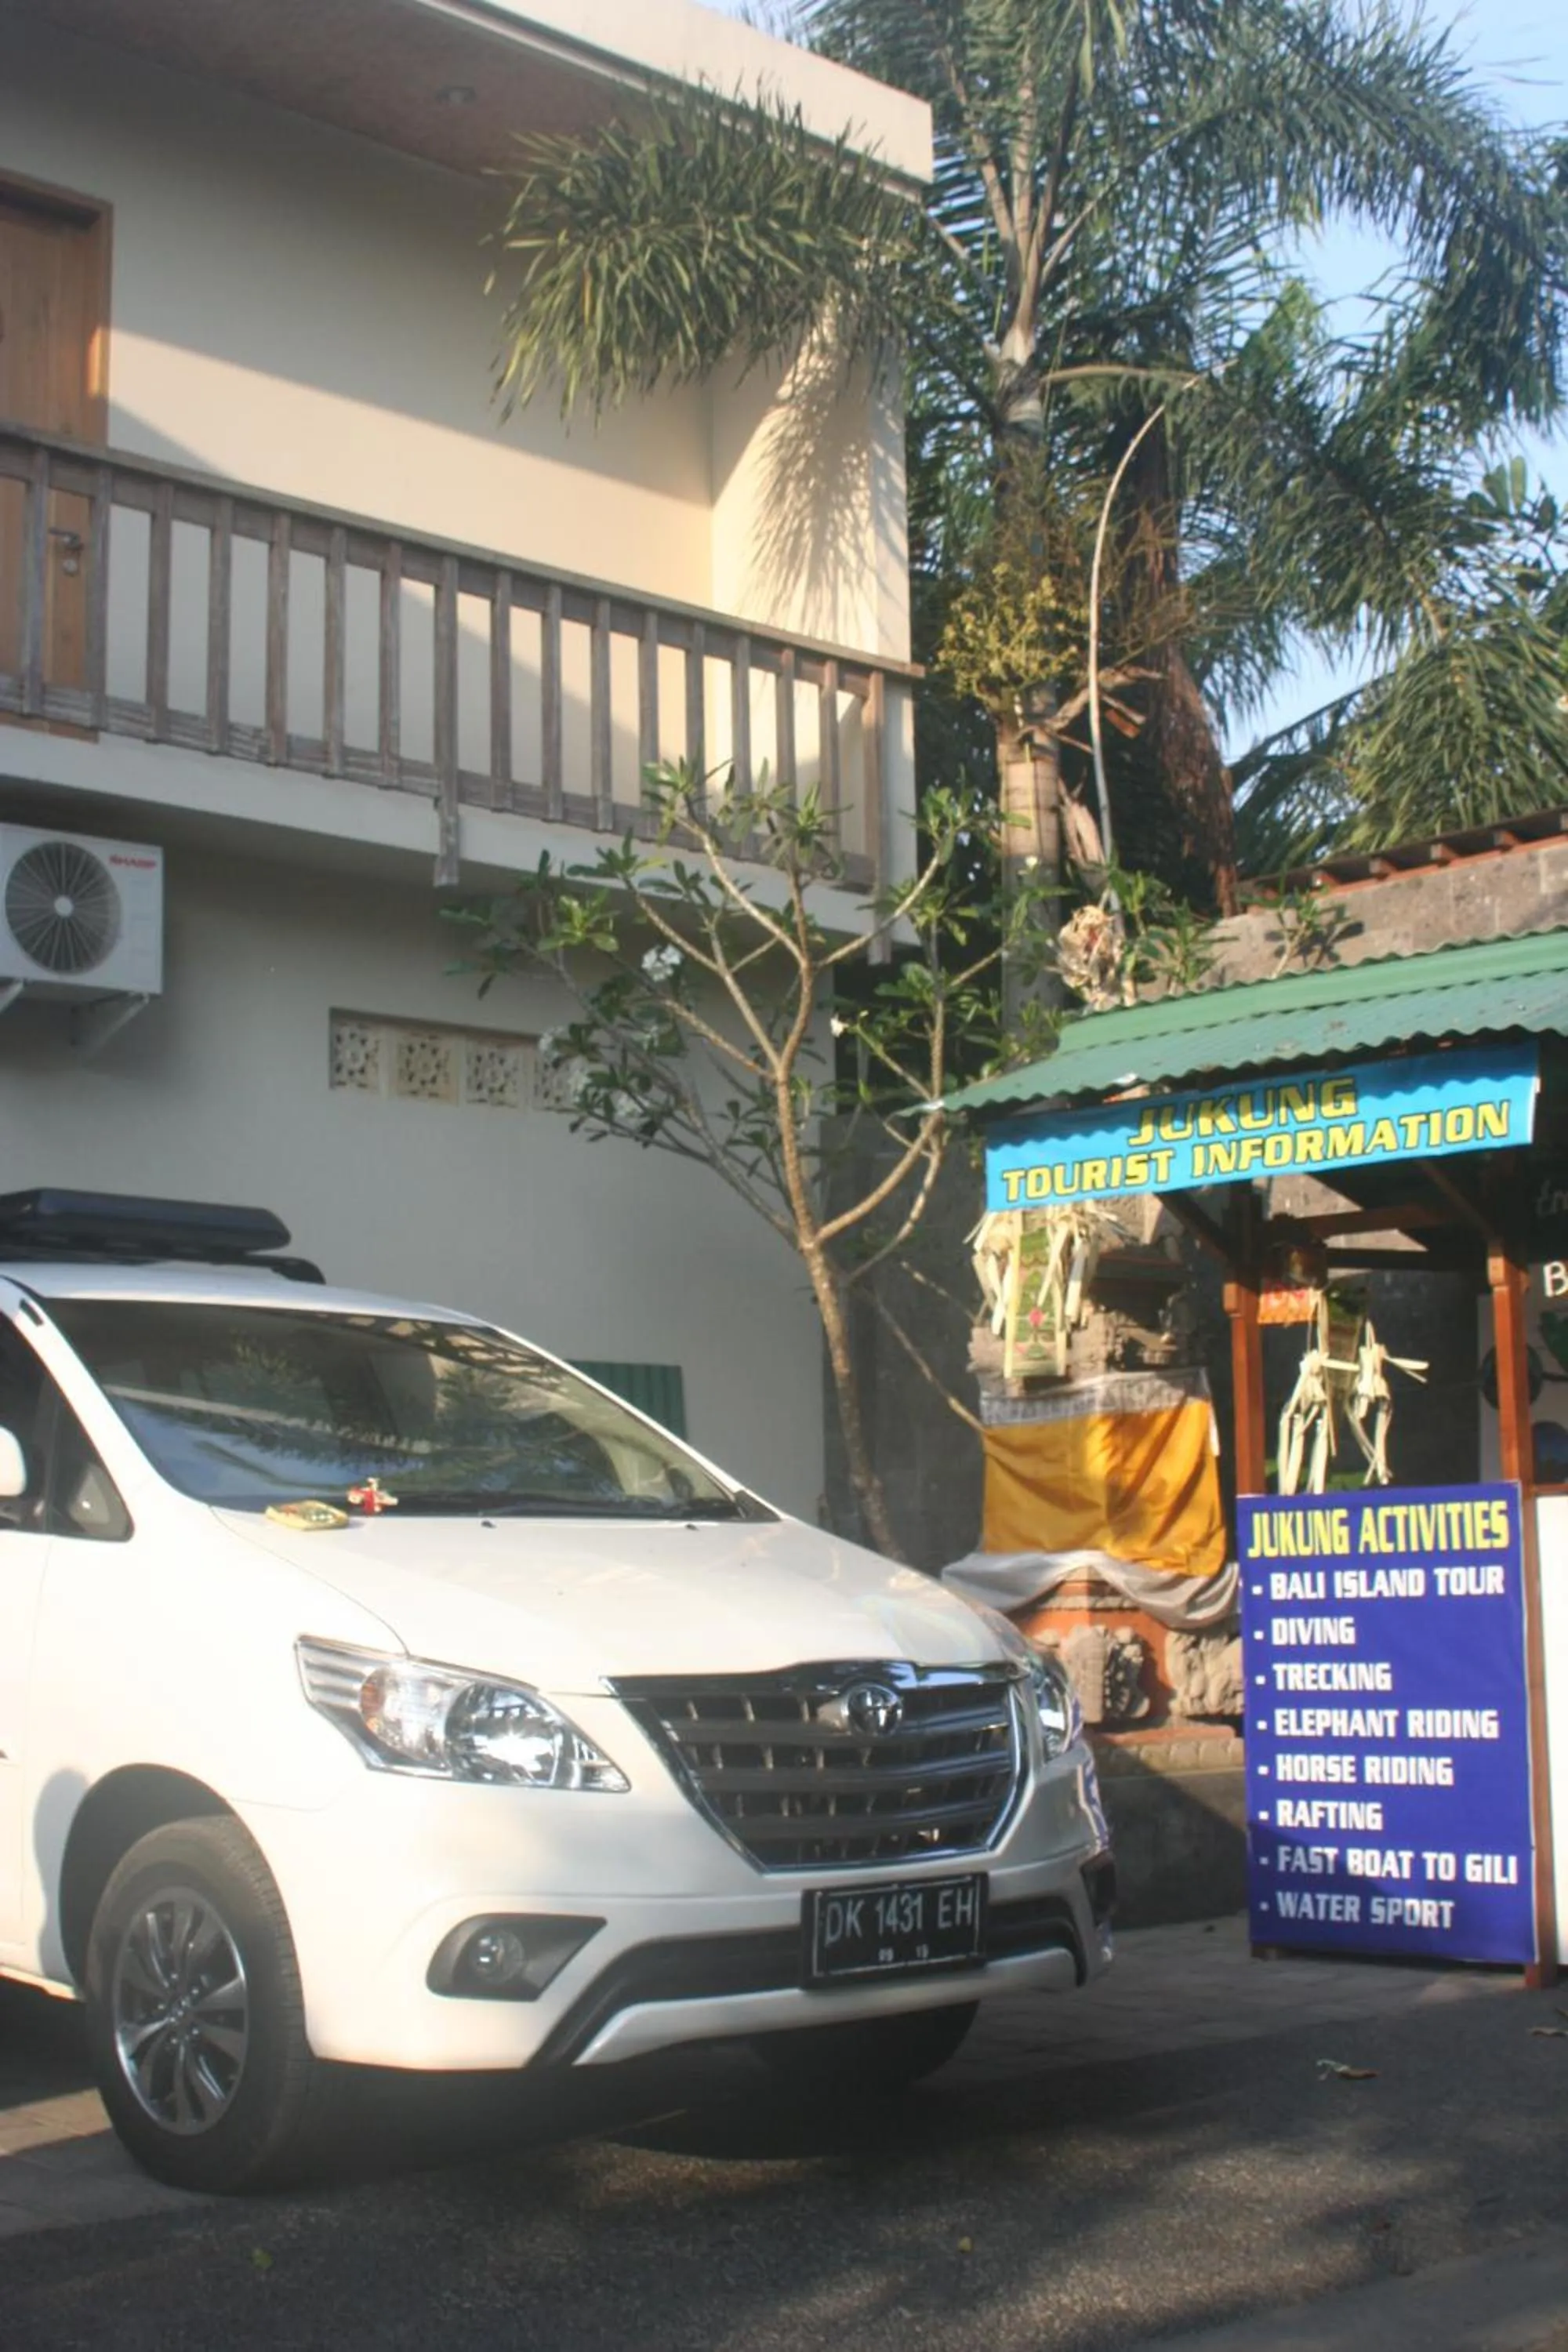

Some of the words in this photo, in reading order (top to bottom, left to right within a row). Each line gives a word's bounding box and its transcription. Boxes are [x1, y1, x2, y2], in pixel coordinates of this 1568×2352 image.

[1127, 1077, 1358, 1146] JUKUNG
[1003, 1149, 1174, 1203] TOURIST
[1192, 1099, 1511, 1178] INFORMATION
[1247, 1508, 1350, 1558] JUKUNG
[1358, 1501, 1510, 1554] ACTIVITIES
[1270, 1571, 1325, 1600] BALI
[1334, 1568, 1425, 1599] ISLAND
[1433, 1566, 1504, 1596] TOUR
[1271, 1617, 1356, 1646] DIVING
[1272, 1662, 1392, 1691] TRECKING
[1274, 1708, 1399, 1737] ELEPHANT
[1407, 1709, 1499, 1739] RIDING
[1276, 1754, 1357, 1784] HORSE
[1364, 1755, 1454, 1786] RIDING
[1276, 1799, 1383, 1831] RAFTING
[1277, 1846, 1338, 1875] FAST
[1346, 1848, 1414, 1879] BOAT
[1421, 1852, 1456, 1882] TO
[1465, 1854, 1518, 1885] GILI
[825, 1898, 865, 1946] DK
[875, 1893, 924, 1936] 1431
[938, 1888, 974, 1929] EH
[1276, 1891, 1361, 1922] WATER
[1370, 1896, 1455, 1929] SPORT
